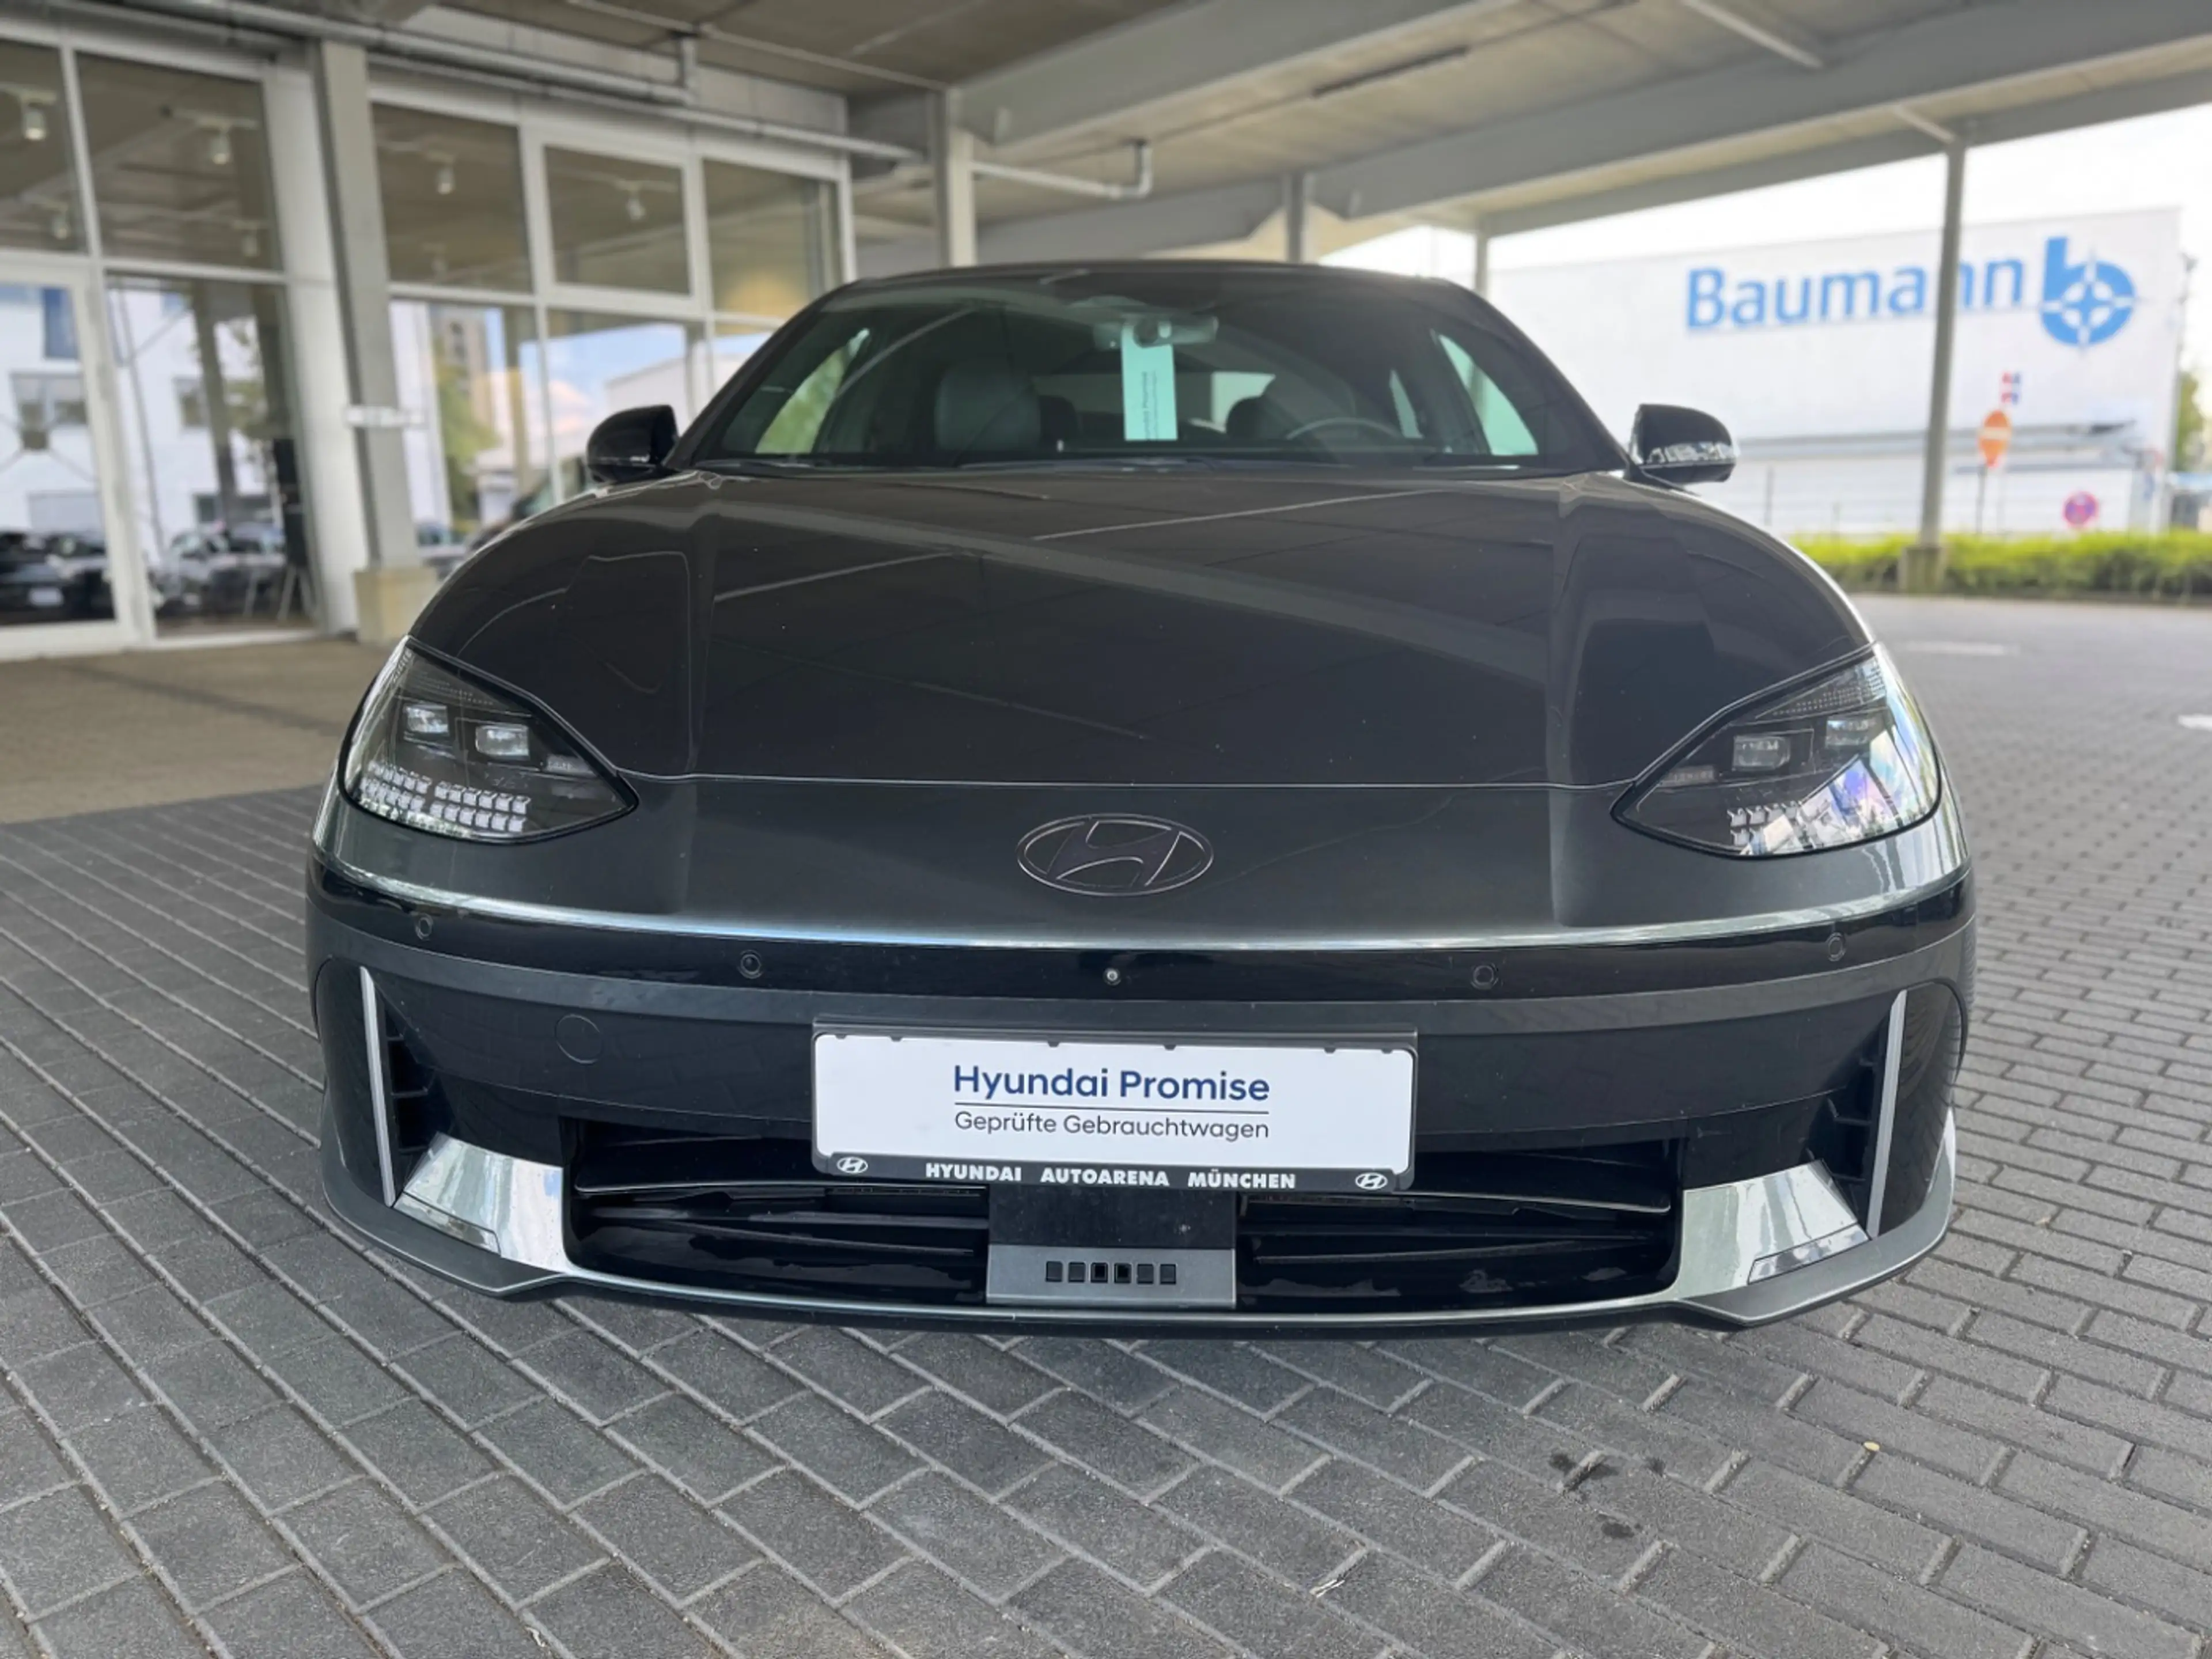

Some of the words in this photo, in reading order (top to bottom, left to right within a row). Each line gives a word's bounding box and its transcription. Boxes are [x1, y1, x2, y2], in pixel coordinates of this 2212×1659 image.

[955, 1065, 1108, 1100] Hyundai
[1120, 1070, 1270, 1101] Promise
[955, 1111, 1056, 1134] Geprüfte
[1063, 1115, 1269, 1142] Gebrauchtwagen
[925, 1162, 1022, 1181] HYUNDAI
[1040, 1167, 1169, 1187] AUTOARENA
[1188, 1169, 1296, 1190] MÜNCHEN
